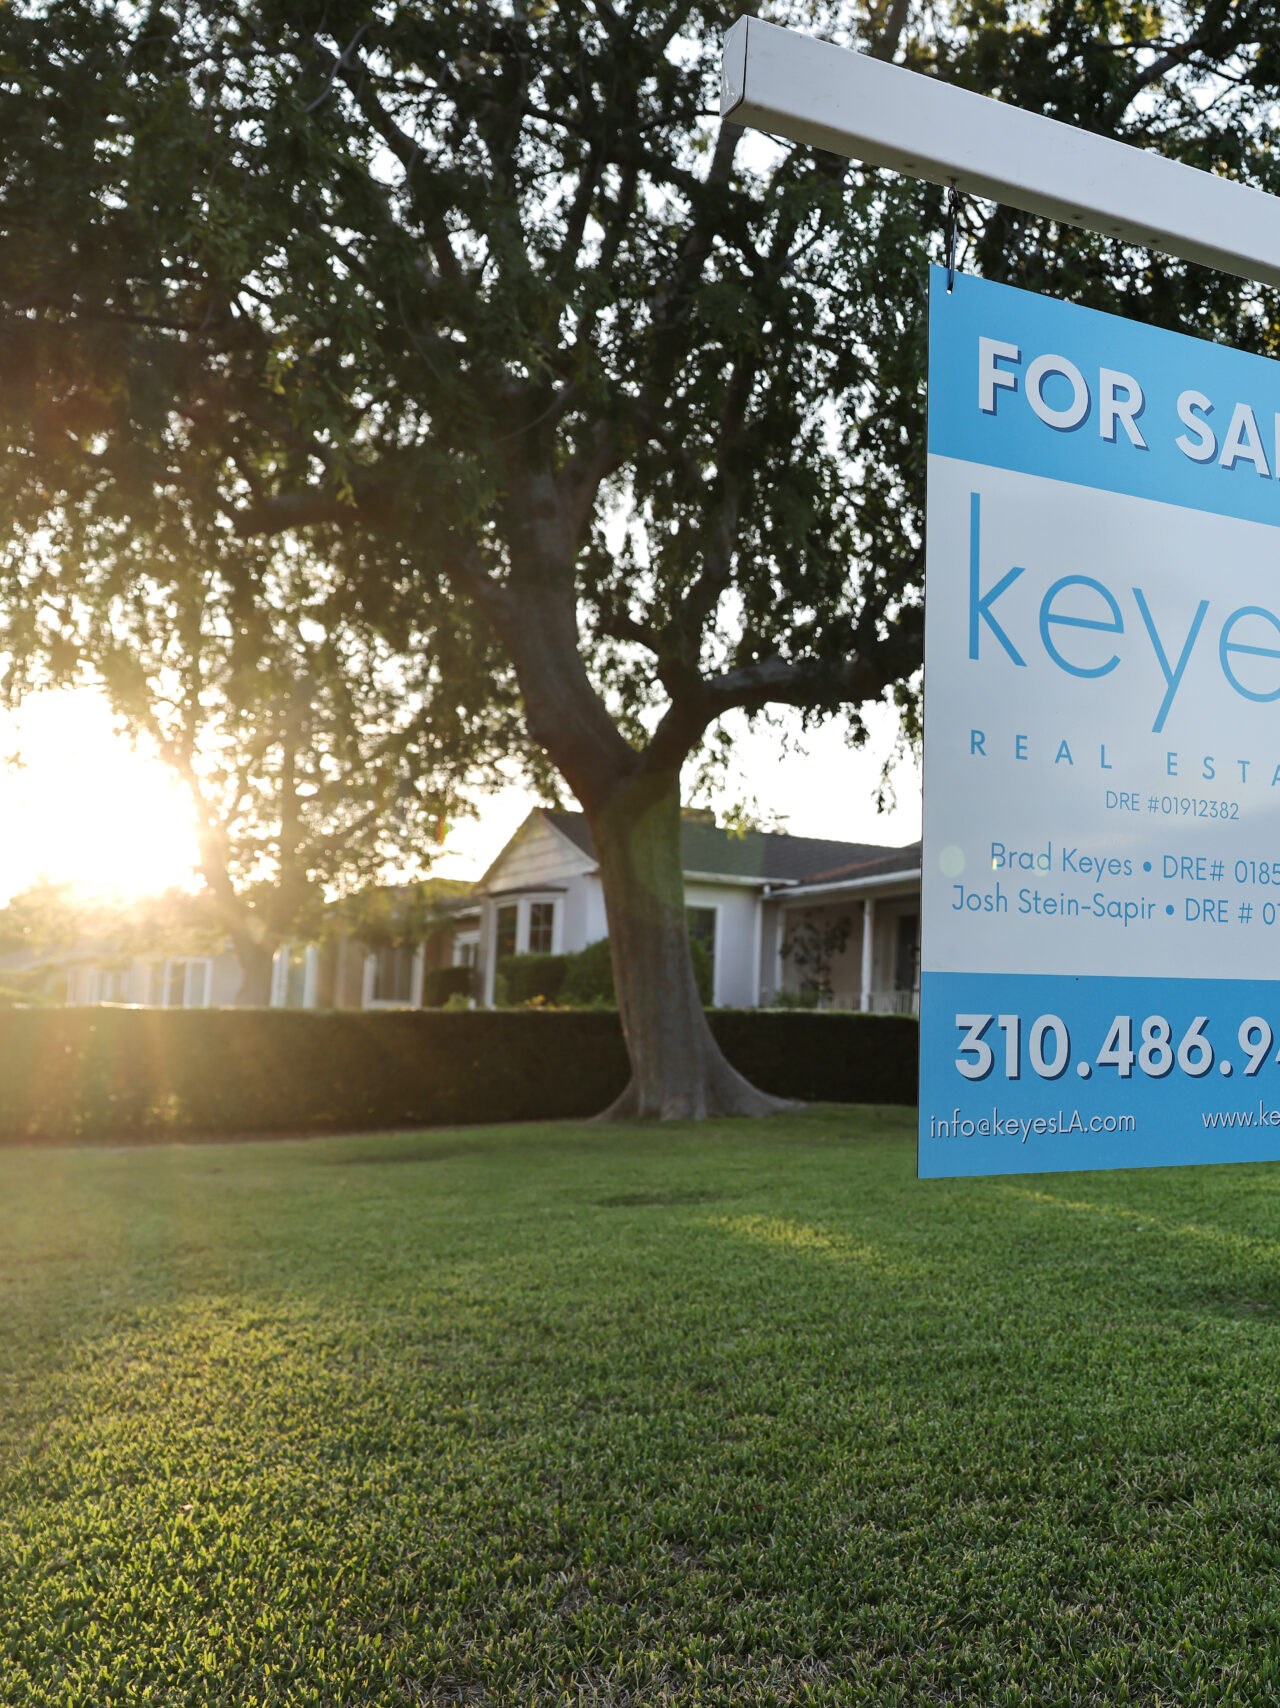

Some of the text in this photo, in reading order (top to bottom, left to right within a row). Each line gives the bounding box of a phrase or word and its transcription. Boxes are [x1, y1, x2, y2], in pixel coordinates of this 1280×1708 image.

[978, 335, 1149, 451] FOR
[970, 729, 1112, 770] REAL
[1105, 790, 1240, 820] DRE #01912382
[990, 841, 1052, 872] Brad
[1062, 847, 1133, 883] Keyes
[1162, 855, 1225, 882] DRE#
[952, 882, 1008, 913] Josh
[1018, 888, 1156, 927] Stein-Sapir
[1185, 898, 1229, 924] DRE
[1238, 901, 1253, 925] #
[930, 1106, 1137, 1144] info@keyesLA.com
